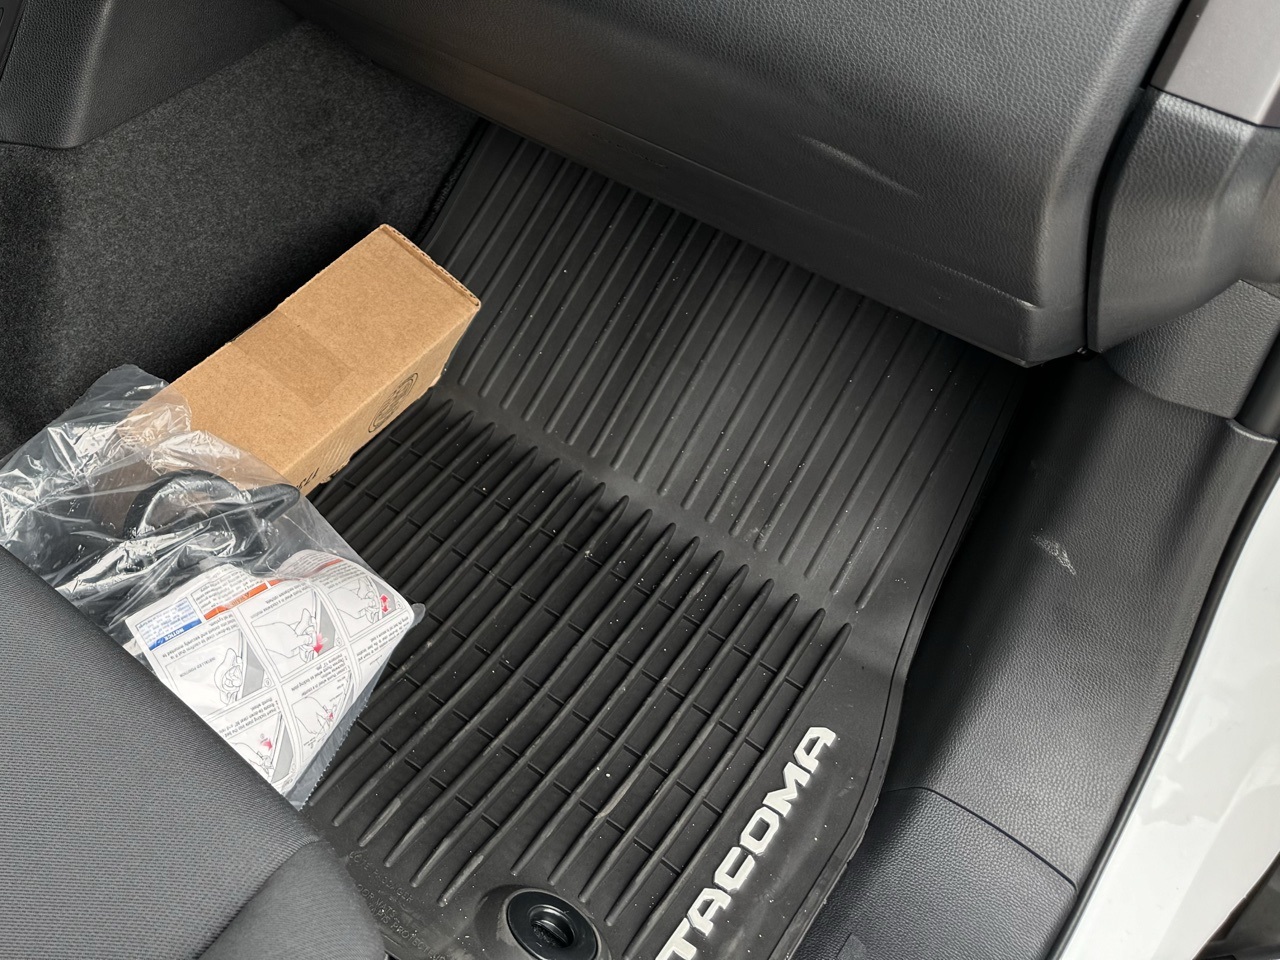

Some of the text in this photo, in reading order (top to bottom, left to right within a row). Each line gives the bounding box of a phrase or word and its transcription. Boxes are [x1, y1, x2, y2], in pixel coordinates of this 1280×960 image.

[163, 626, 184, 640] NOTICE
[184, 636, 200, 648] securely
[186, 641, 201, 652] confirm
[178, 649, 186, 657] that
[253, 712, 266, 722] locking
[654, 726, 837, 960] TACOMA
